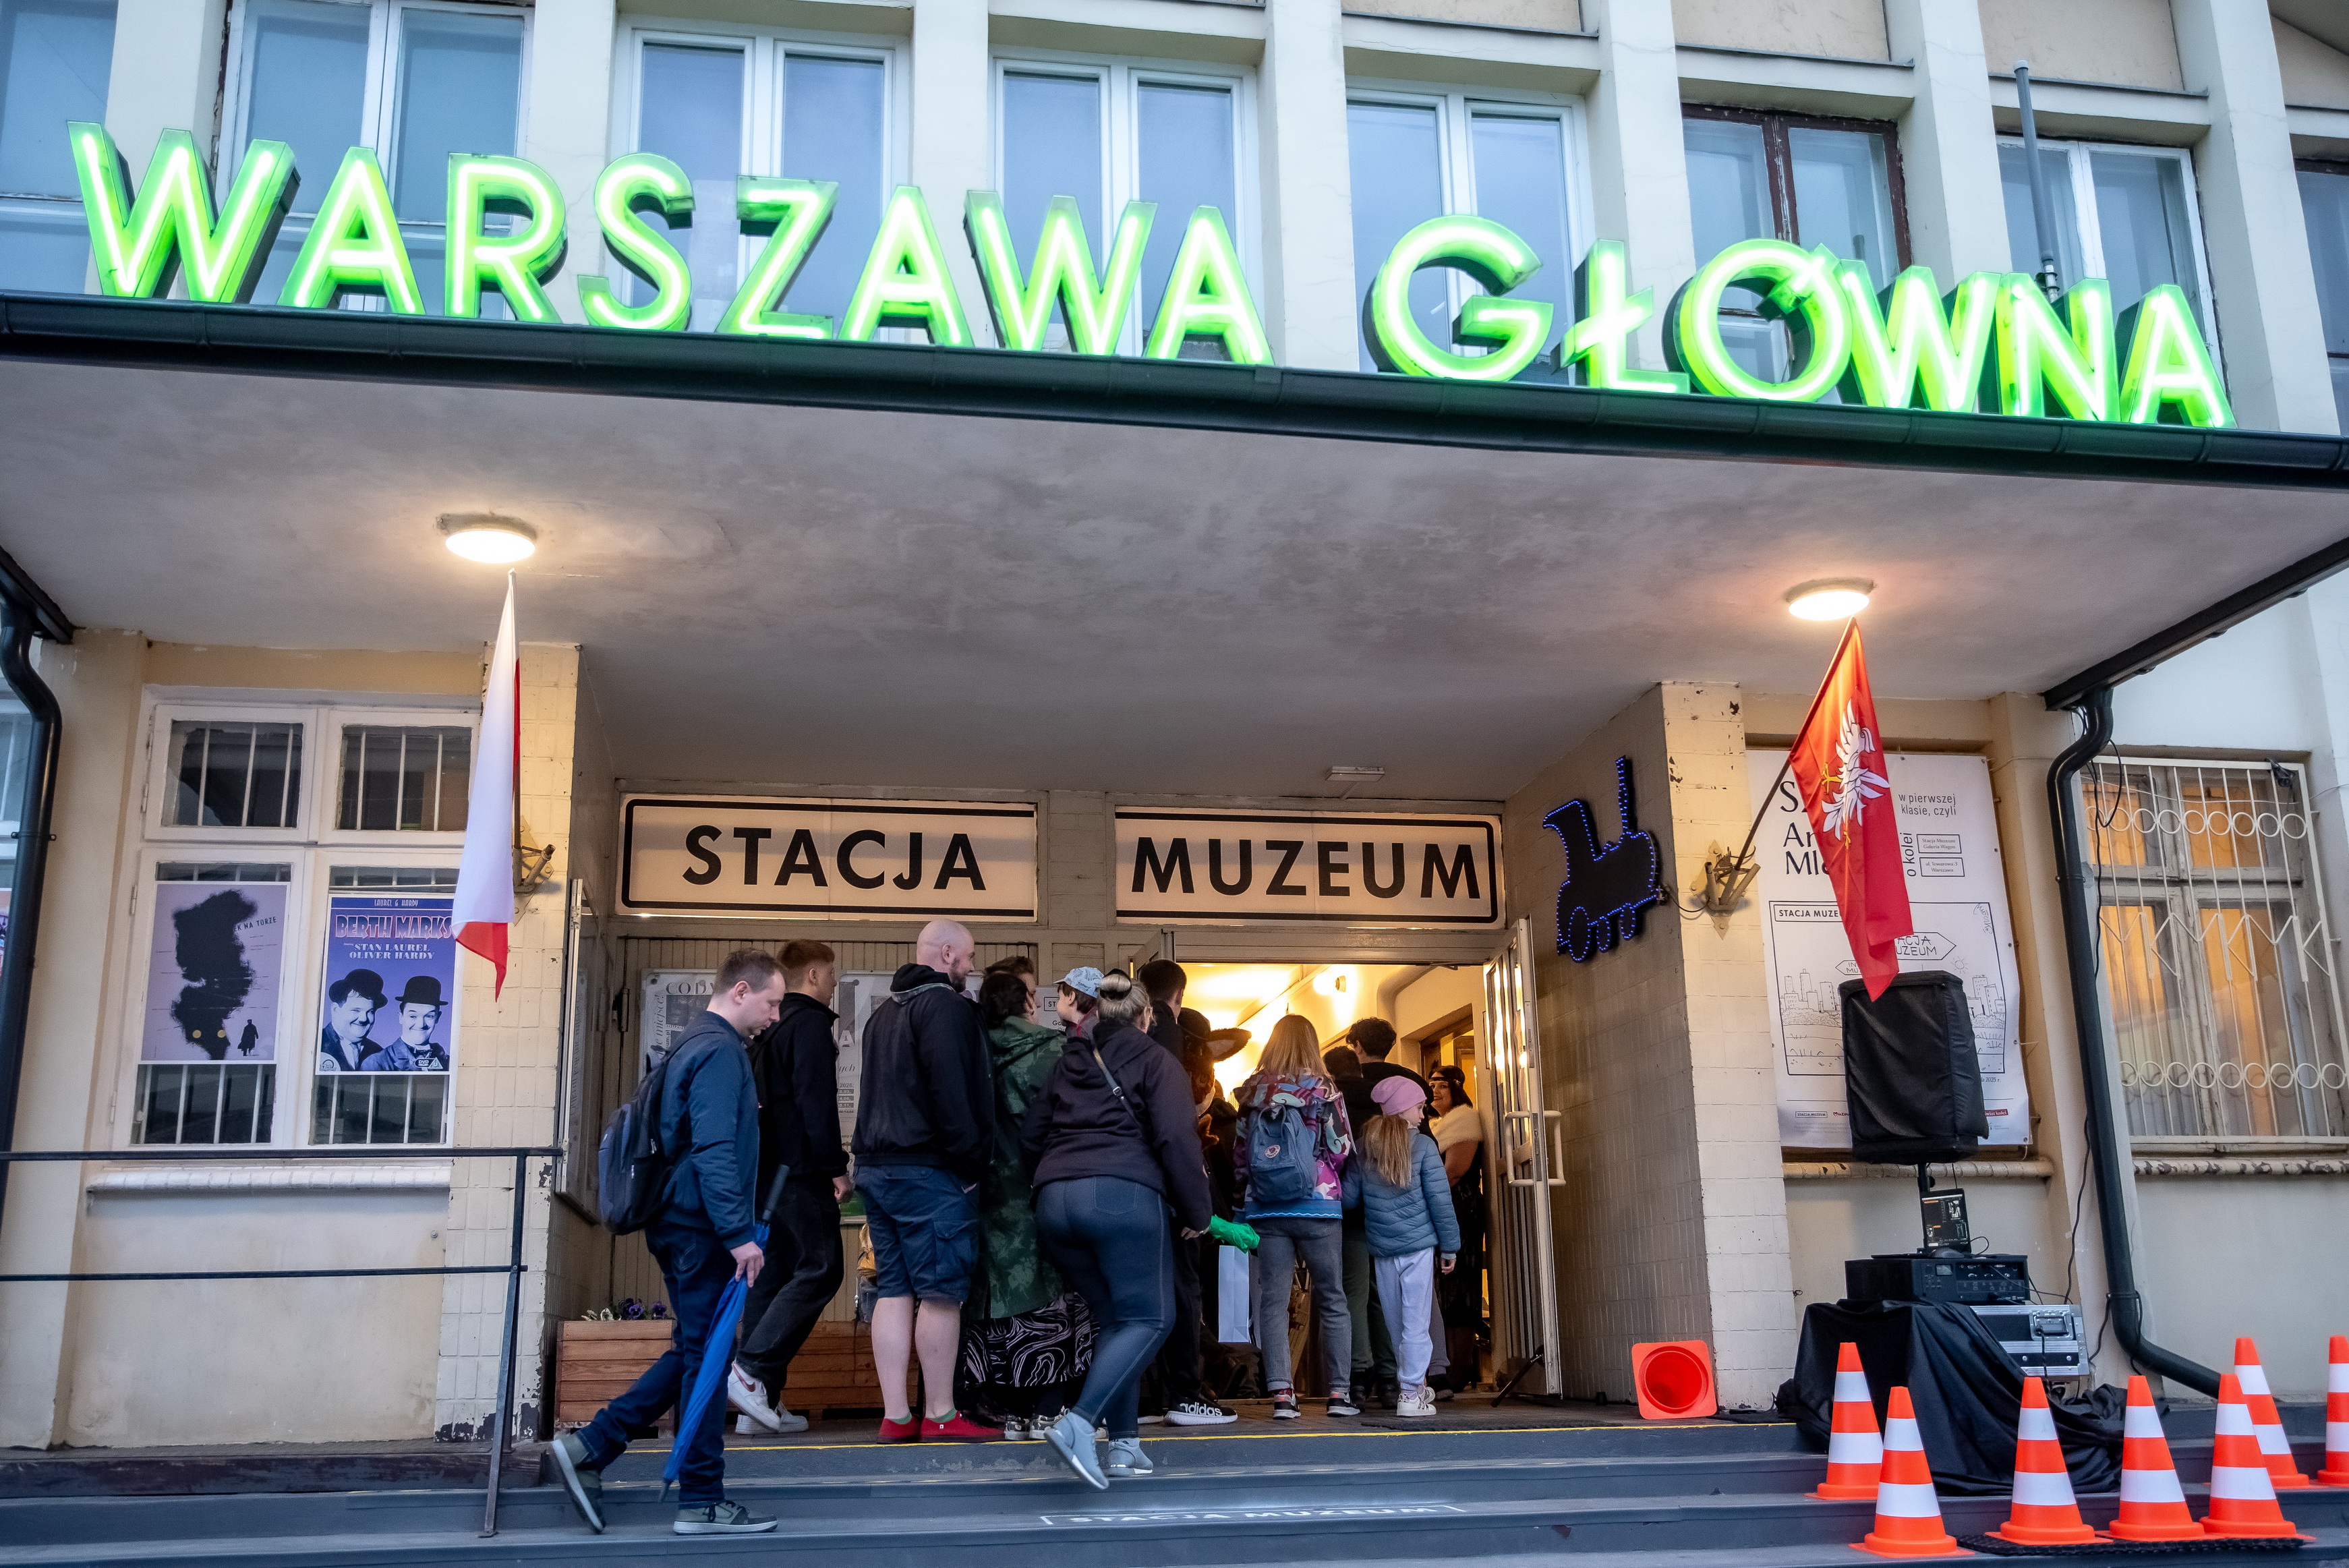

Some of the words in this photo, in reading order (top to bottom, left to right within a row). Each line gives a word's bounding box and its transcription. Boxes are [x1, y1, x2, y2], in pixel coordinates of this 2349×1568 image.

[67, 120, 1275, 366] WARSZAWA
[1364, 214, 2237, 430] GŁÓWNA
[1909, 792, 1956, 806] pierwszej
[1901, 804, 1930, 817] klasie,
[1934, 805, 1956, 818] czyli
[1899, 832, 1915, 864] kolei
[682, 824, 987, 891] STACJA
[1131, 836, 1481, 899] MUZEUM
[256, 917, 277, 927] TORZE
[335, 914, 393, 939] BERTH
[394, 915, 452, 939] MARKS
[385, 943, 430, 952] LAUREL
[1897, 935, 1932, 946] ACJA
[1896, 946, 1937, 956] UZEUM
[1180, 1402, 1223, 1416] adidas
[1070, 1514, 1231, 1522] STACJA
[1245, 1508, 1437, 1517] MUZEUM
